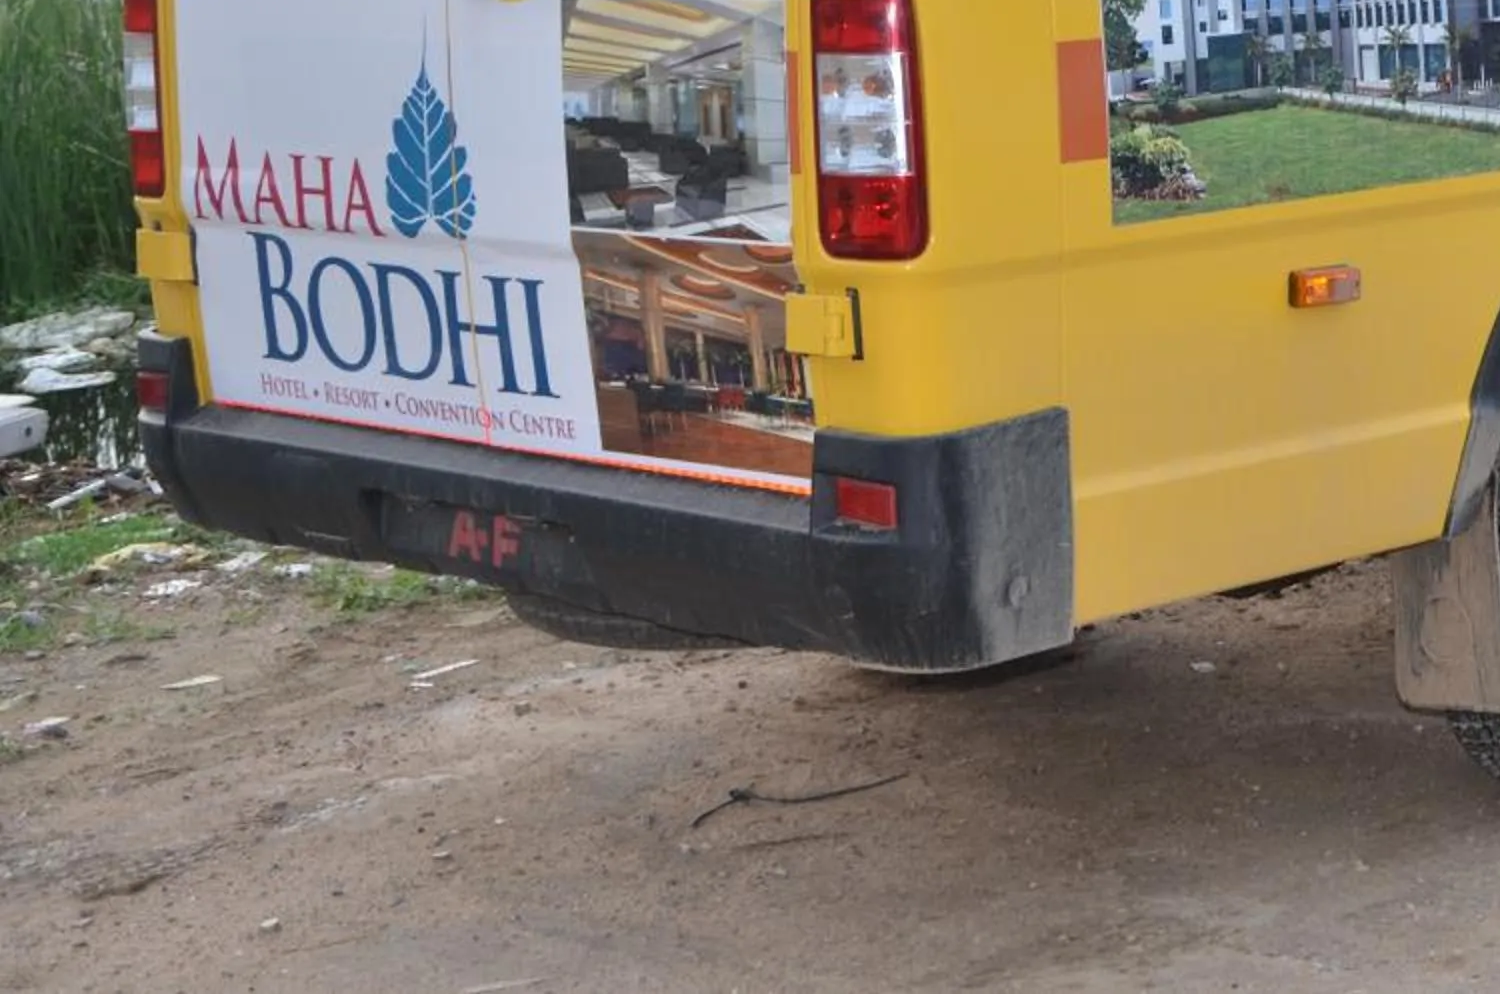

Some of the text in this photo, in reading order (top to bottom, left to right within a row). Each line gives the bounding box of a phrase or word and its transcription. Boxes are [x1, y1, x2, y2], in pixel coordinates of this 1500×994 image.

[194, 133, 388, 237] MAHA
[246, 230, 561, 398] BODHI
[261, 373, 577, 440] HOTEL RESORT CONVENTION CENTRE
